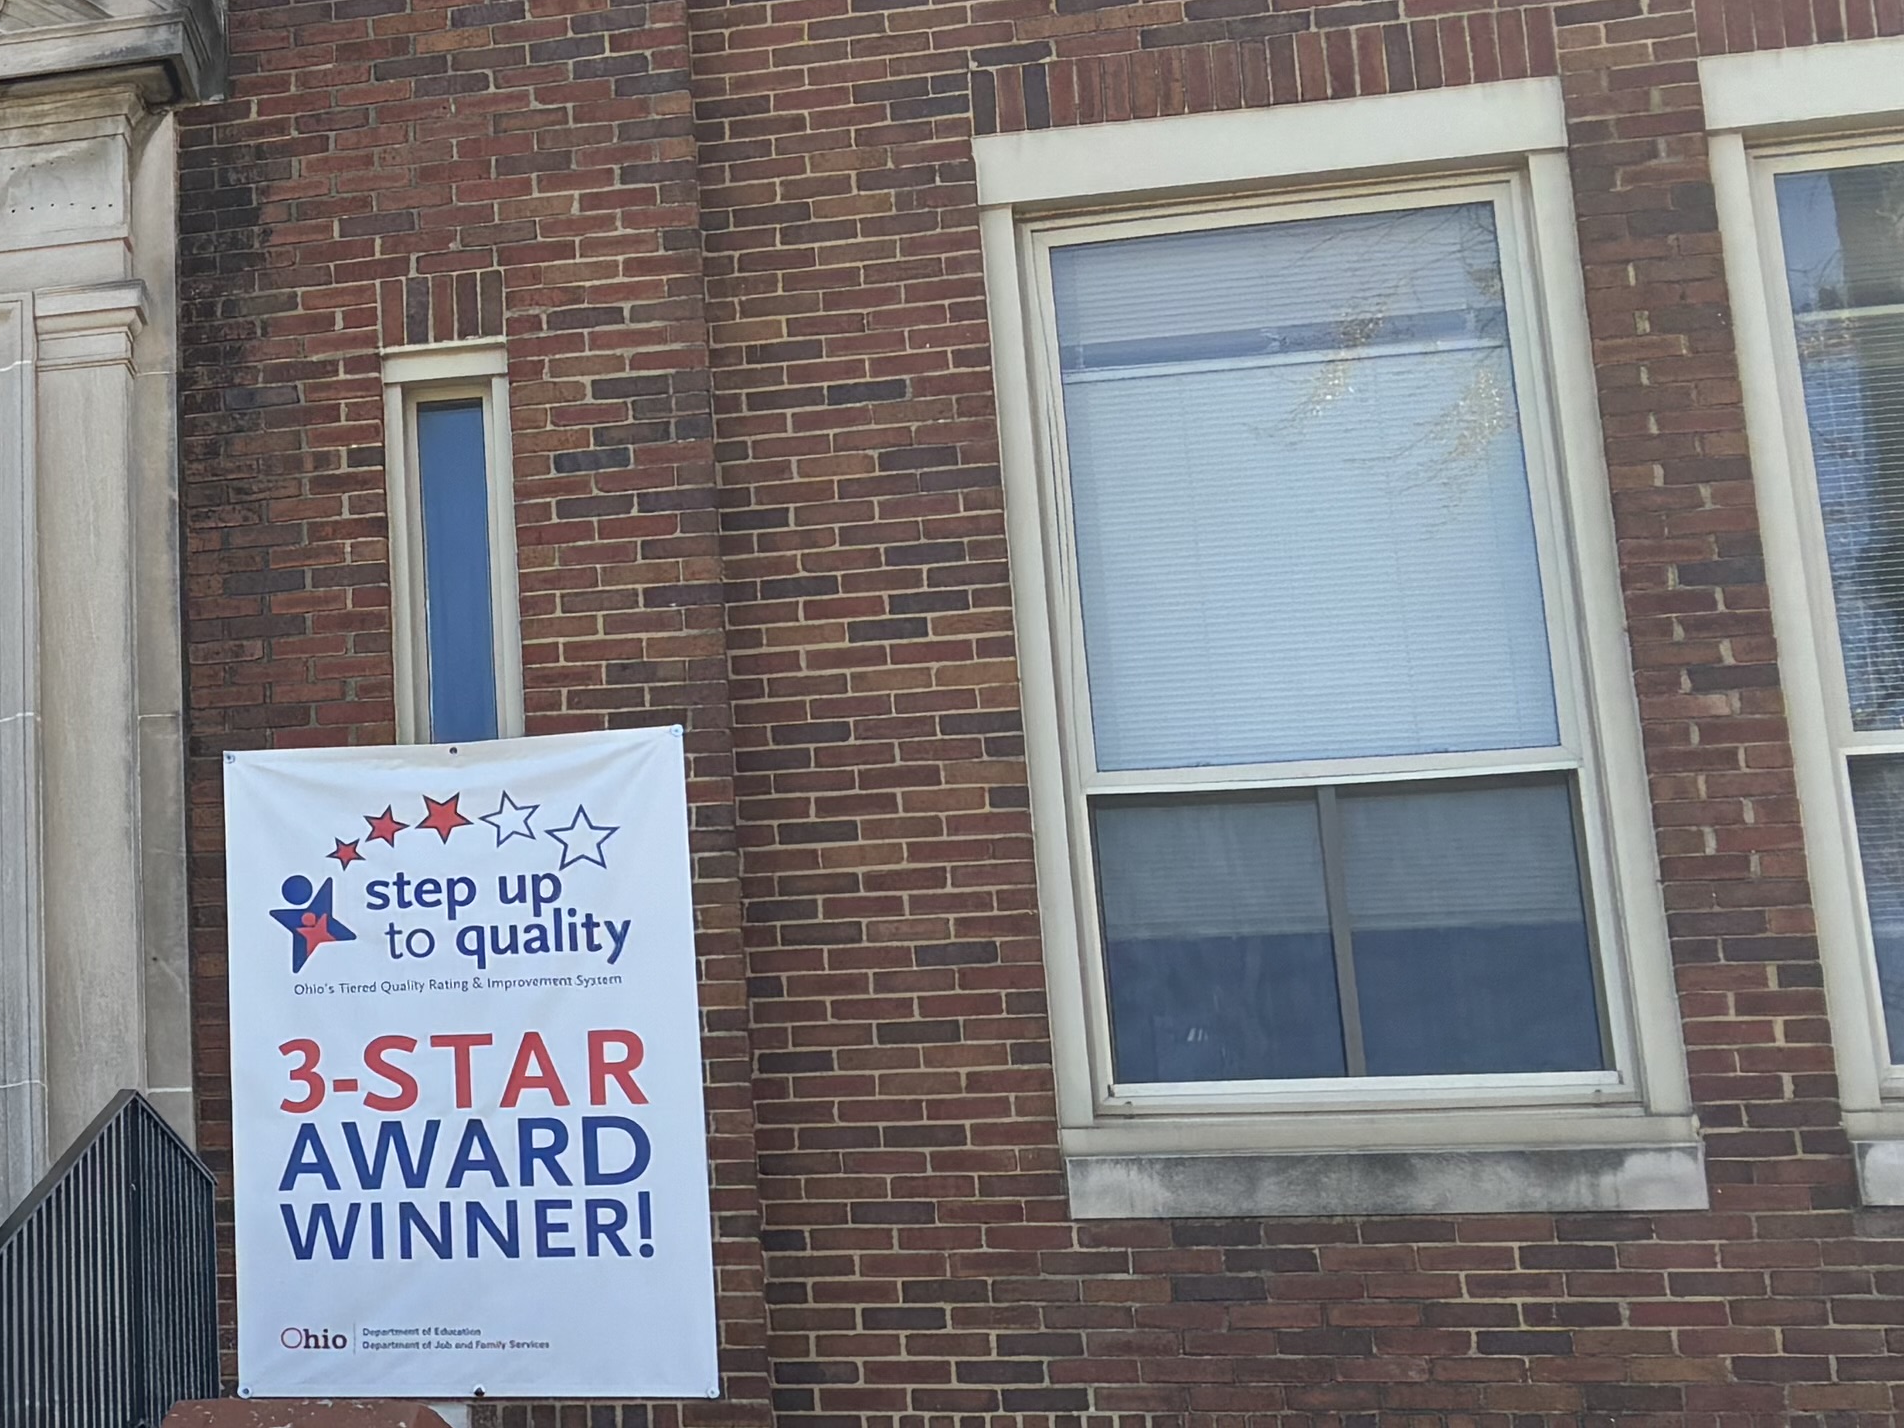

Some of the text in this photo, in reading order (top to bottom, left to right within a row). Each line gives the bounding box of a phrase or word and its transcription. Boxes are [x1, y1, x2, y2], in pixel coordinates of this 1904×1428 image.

[365, 872, 562, 920] step up
[385, 907, 631, 969] to quality
[294, 974, 622, 995] Ohio's Tiered Quality Rating & Improvement System
[278, 1029, 649, 1113] 3-STAR
[278, 1116, 651, 1191] AWARD
[279, 1191, 654, 1260] WINNER!
[281, 1327, 347, 1349] Ohio
[362, 1327, 419, 1337] Department
[434, 1327, 481, 1336] Education
[475, 1340, 506, 1350] Family
[509, 1339, 549, 1349] Services
